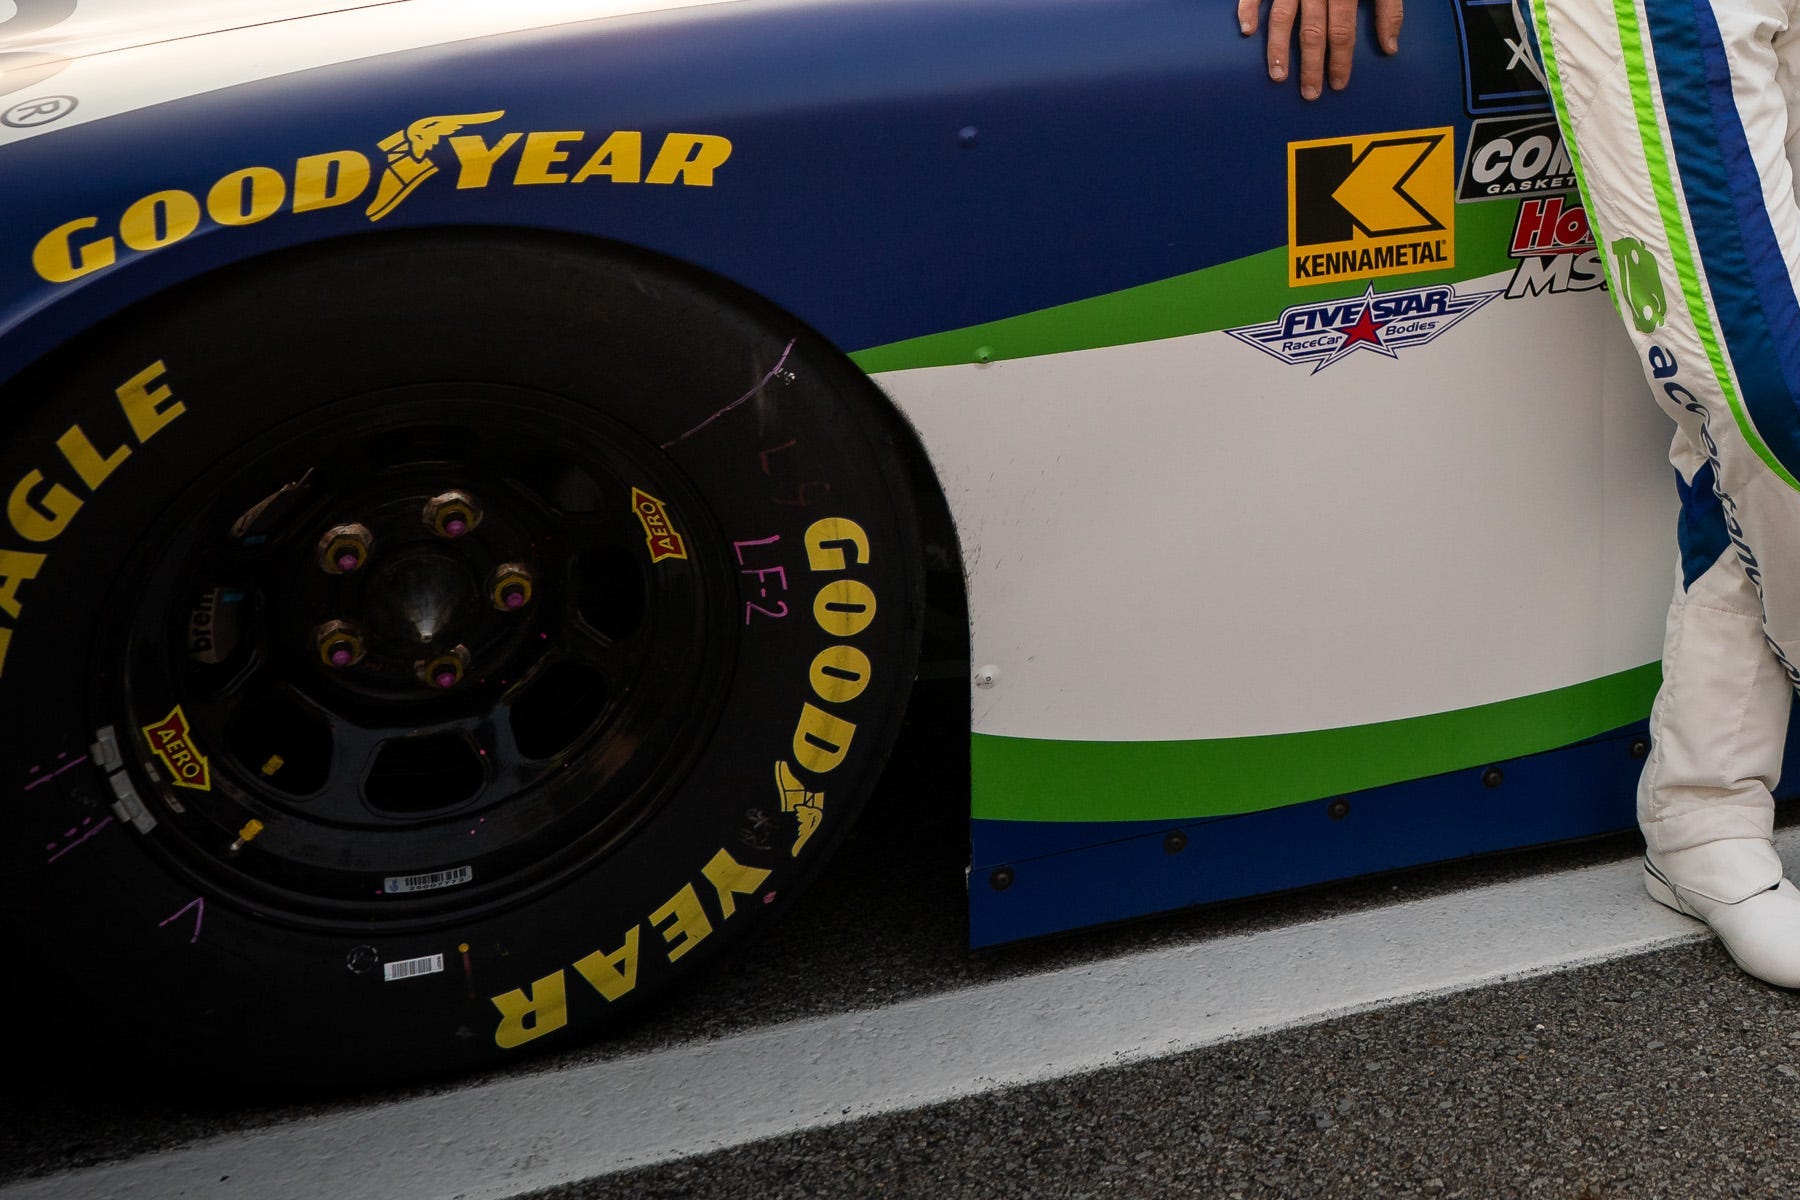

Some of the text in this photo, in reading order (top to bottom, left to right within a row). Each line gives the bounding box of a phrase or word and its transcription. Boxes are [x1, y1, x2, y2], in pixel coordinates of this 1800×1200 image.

[1295, 241, 1448, 279] KENNAMETAL
[1281, 289, 1450, 337] FIVE STAR
[1385, 320, 1437, 337] Bodies
[0, 359, 188, 678] AGLE
[643, 500, 677, 552] AERO
[156, 727, 201, 780] AERO
